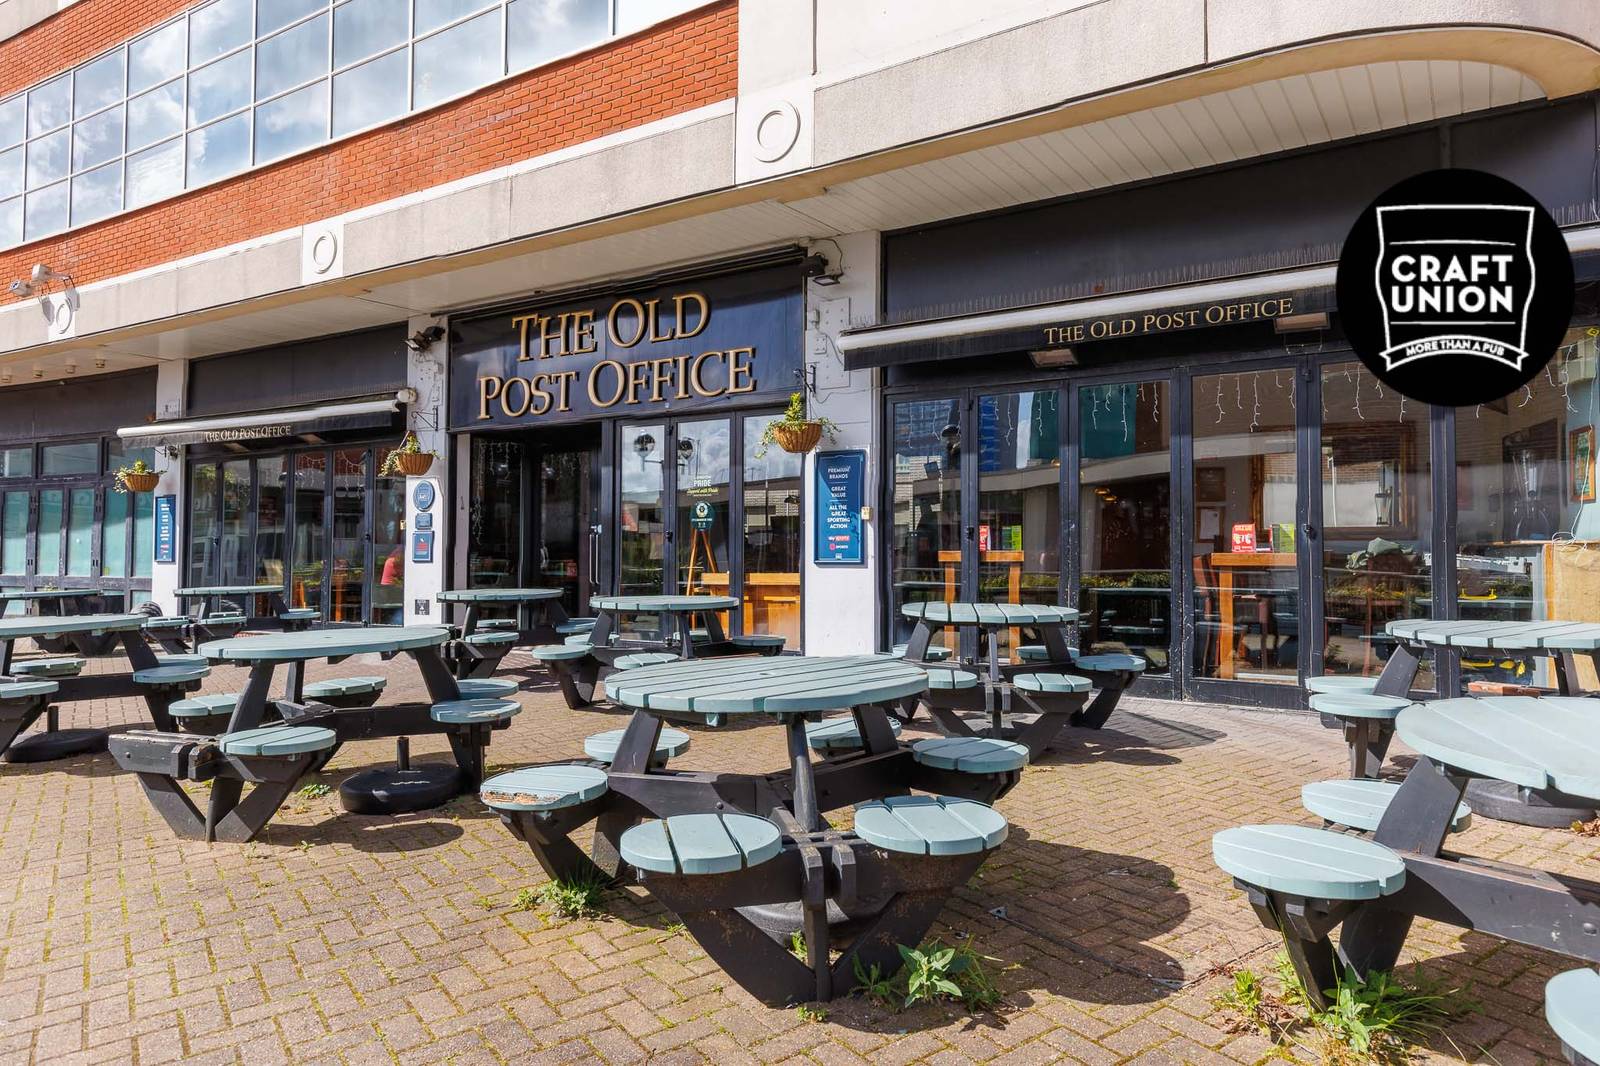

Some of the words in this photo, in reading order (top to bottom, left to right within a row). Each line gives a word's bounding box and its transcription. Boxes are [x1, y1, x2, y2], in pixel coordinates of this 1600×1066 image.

[512, 309, 598, 362] THE
[608, 291, 710, 348] OLD
[1044, 325, 1085, 345] THE
[1090, 318, 1136, 338] OLD
[1143, 310, 1200, 332] POST
[1205, 298, 1294, 324] OFFICE
[477, 371, 579, 420] POST
[587, 347, 757, 408] OFFICE
[205, 431, 219, 442] THE
[220, 429, 238, 441] OLD
[239, 427, 260, 440] POST
[260, 425, 291, 438] OFFICE
